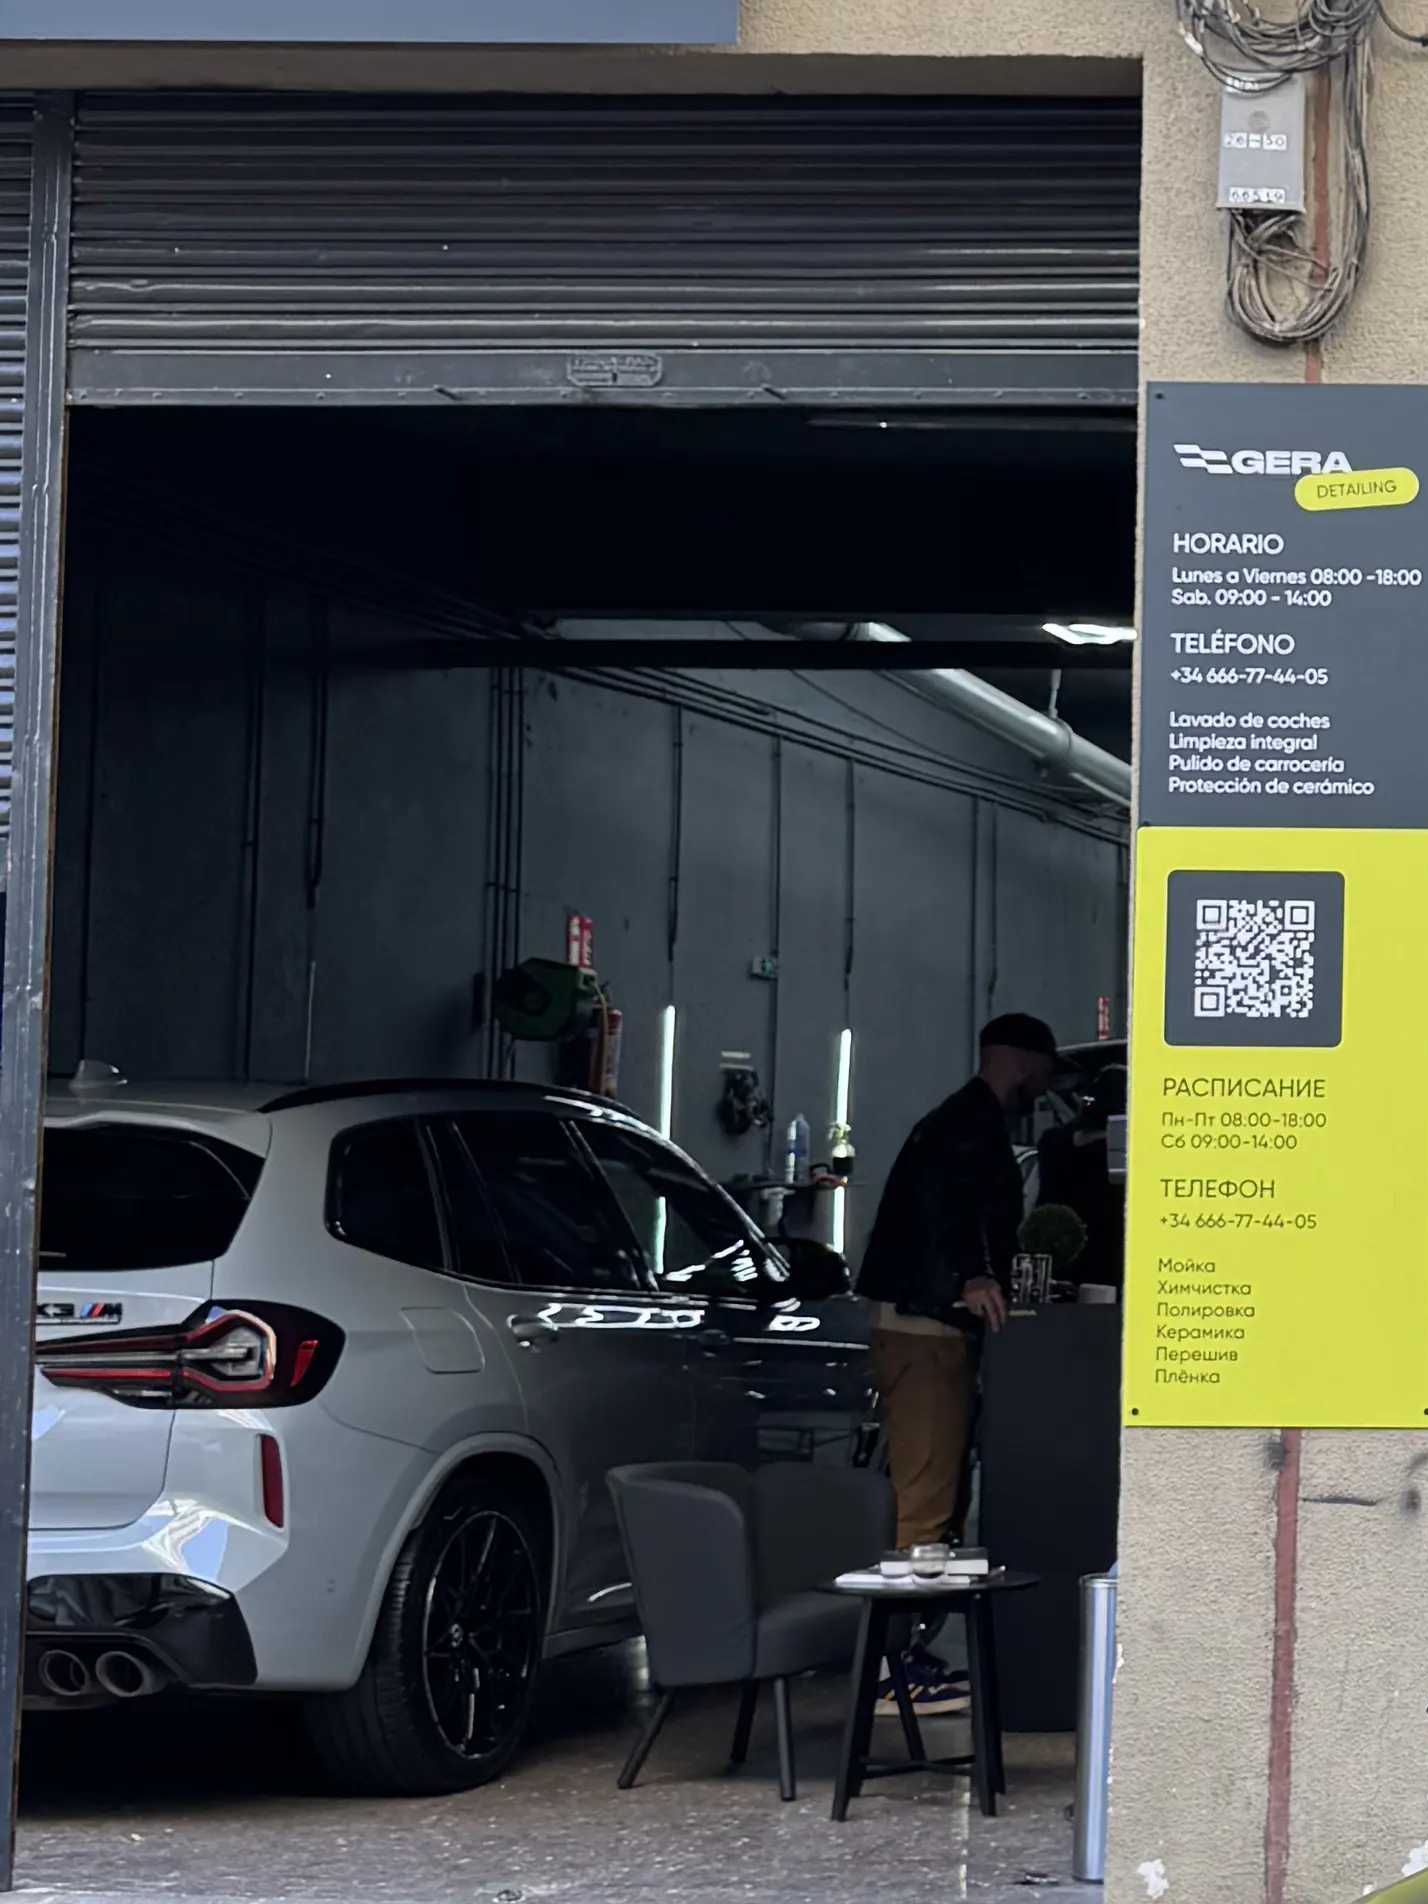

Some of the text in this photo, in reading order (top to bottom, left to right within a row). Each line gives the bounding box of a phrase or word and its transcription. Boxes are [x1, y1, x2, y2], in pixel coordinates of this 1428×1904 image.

[1231, 450, 1353, 475] GERA
[1317, 480, 1396, 498] DETAILING
[1174, 533, 1283, 554] HORARIO
[1172, 567, 1223, 583] Lunes
[1226, 571, 1239, 583] a
[1243, 568, 1306, 584] Viernes
[1311, 568, 1362, 585] 08:00
[1172, 588, 1211, 605] Sab.
[1215, 589, 1267, 605] 09:00
[1285, 590, 1331, 606] 14:00
[1171, 629, 1295, 654] TELÉFONO
[1171, 667, 1328, 684] +34 666-77-44-05
[1170, 711, 1330, 728] Lavado de coches
[1169, 733, 1317, 753] Limpieza integral
[1169, 755, 1344, 772] Pulido de carrocería
[1169, 777, 1374, 794] Protección de cerámico
[1164, 1078, 1325, 1097] РАСПИСАНИЕ
[1162, 1112, 1326, 1127] Пн-Пт 08:00-18:00
[1161, 1134, 1297, 1149] Сб 09:00-14:00
[1161, 1179, 1274, 1198] ТЕЛЕФОН
[1161, 1213, 1316, 1229] +34 666-77-44-05
[1159, 1258, 1215, 1272] Мойка
[1158, 1281, 1251, 1295] Химчистка
[1157, 1302, 1255, 1320] Полировка
[1157, 1325, 1244, 1342] Керамика
[1156, 1347, 1237, 1364] Перешив
[1156, 1369, 1220, 1383] Плёнка
